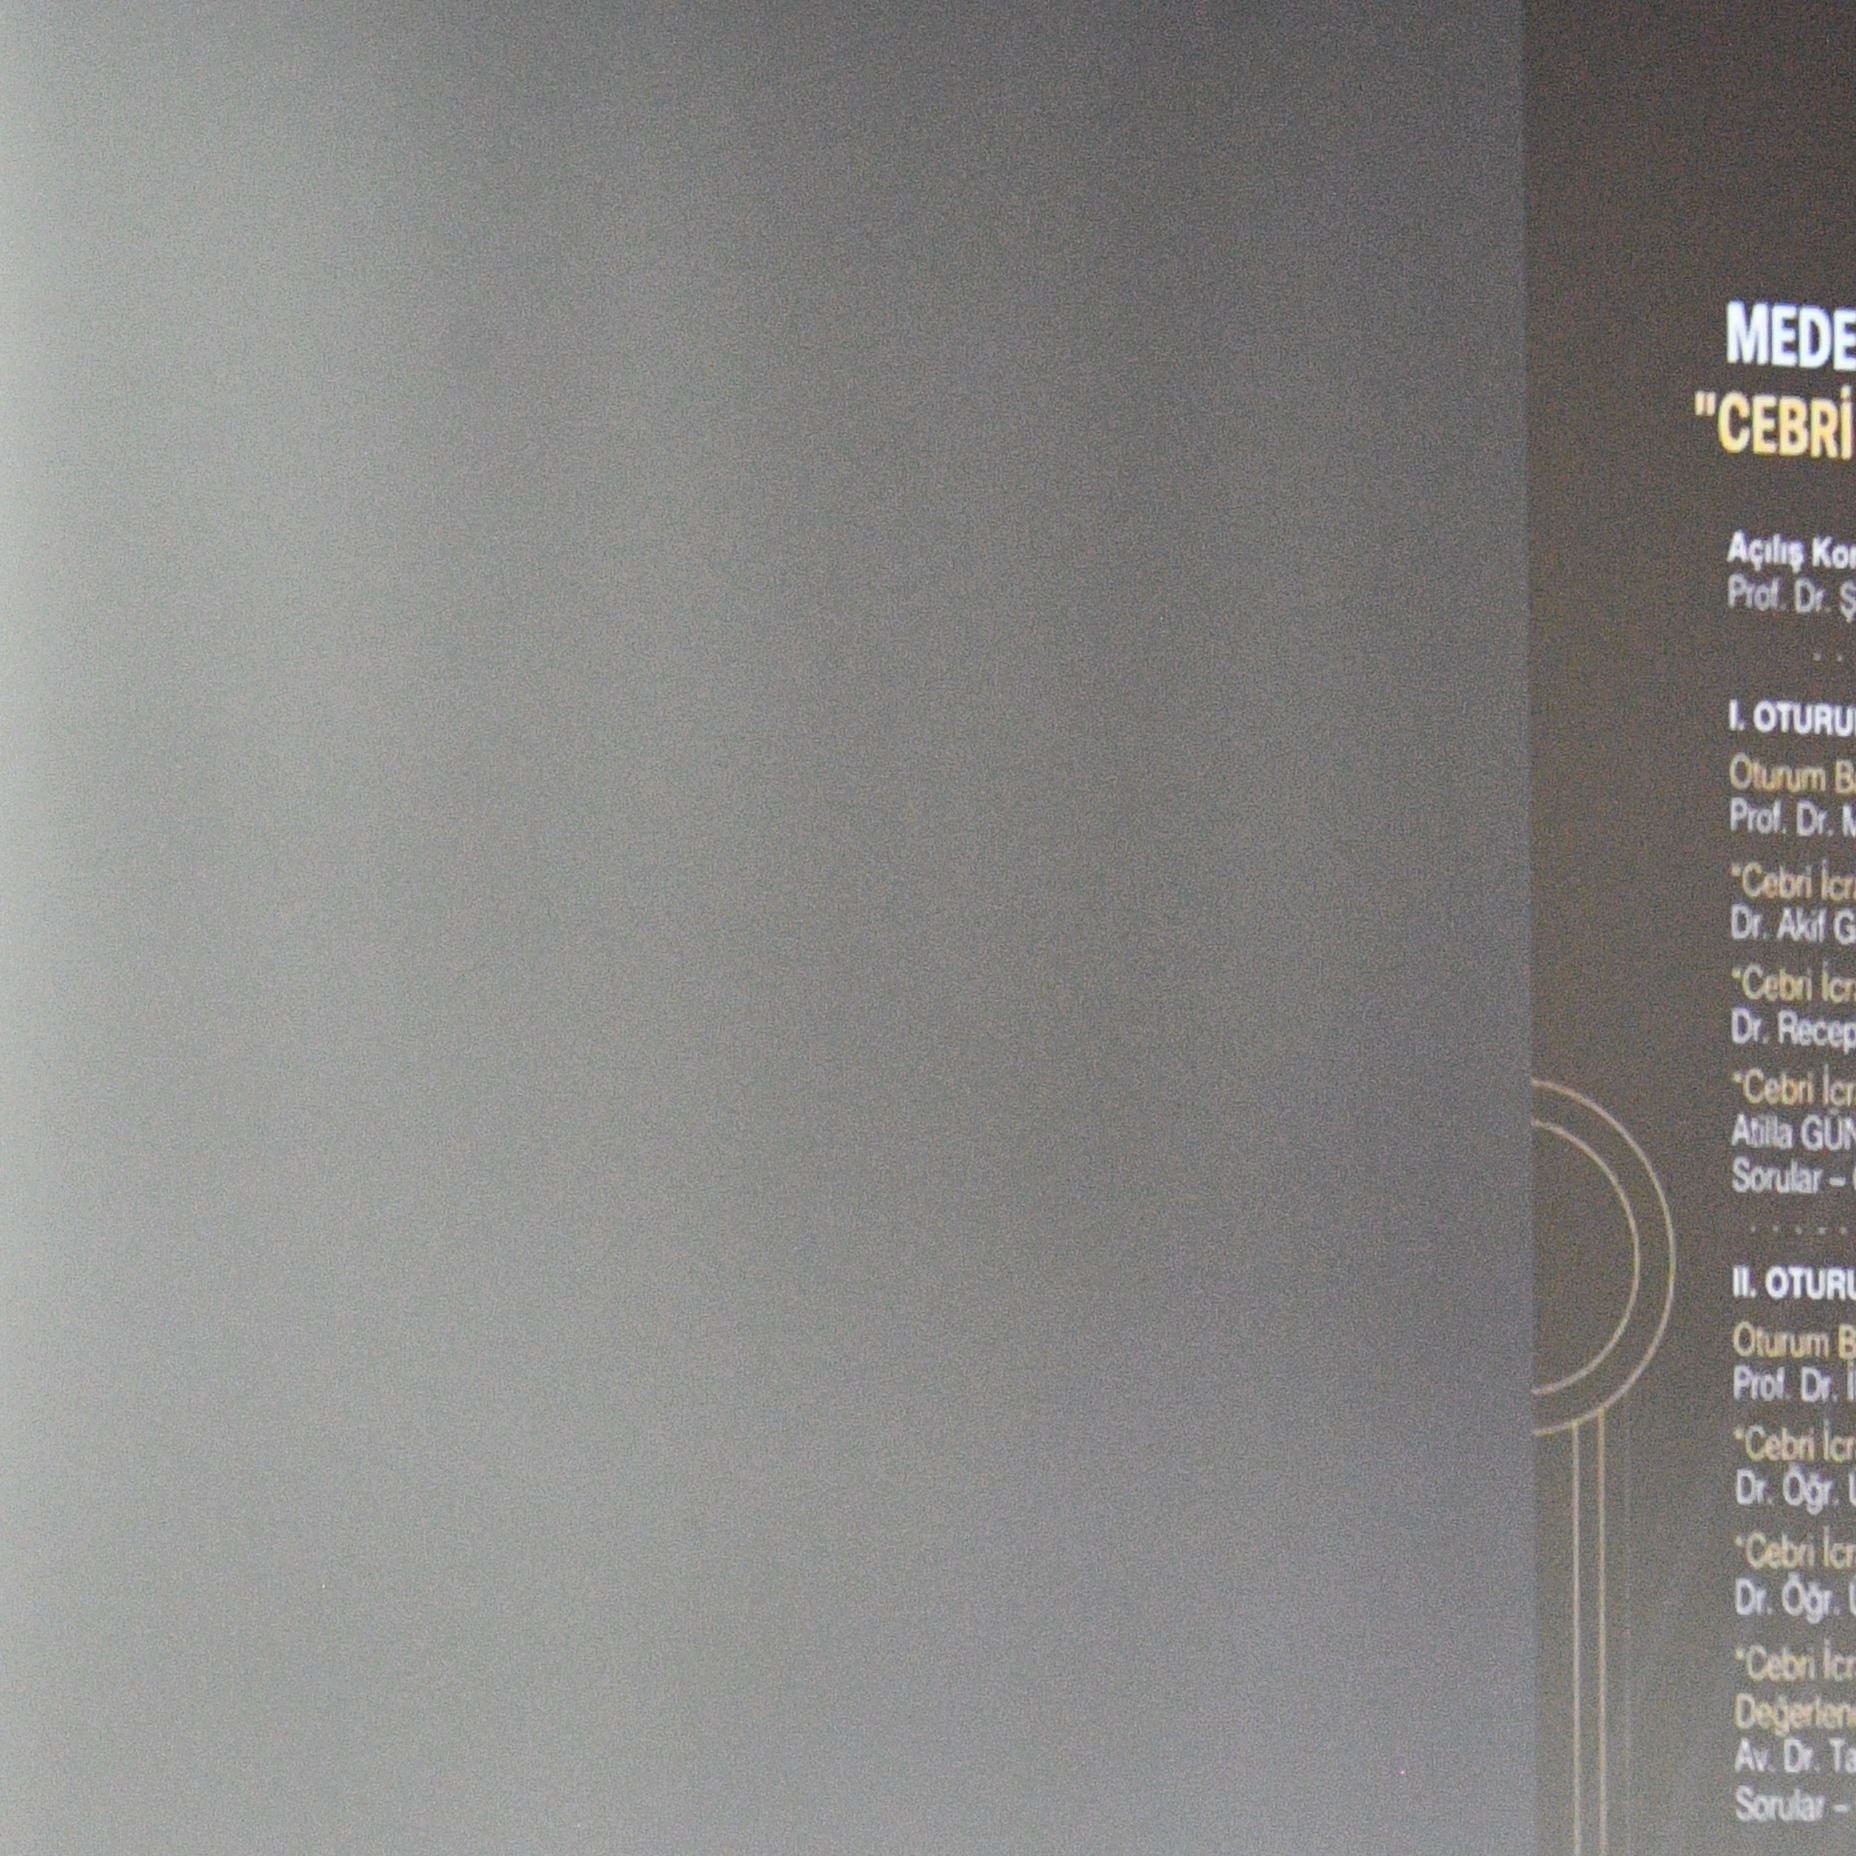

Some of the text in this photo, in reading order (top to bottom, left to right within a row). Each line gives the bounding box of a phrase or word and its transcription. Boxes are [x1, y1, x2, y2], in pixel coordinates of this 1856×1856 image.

[1694, 388, 1855, 463] "CEBRİ
[1726, 527, 1807, 577] Açılış
[1726, 697, 1747, 732] I.
[1776, 906, 1826, 942] Akif
[1730, 1114, 1794, 1150] Atilla
[1730, 1159, 1822, 1195] Sorular
[1730, 1263, 1758, 1298] II.
[1733, 1787, 1825, 1821] Sorular
